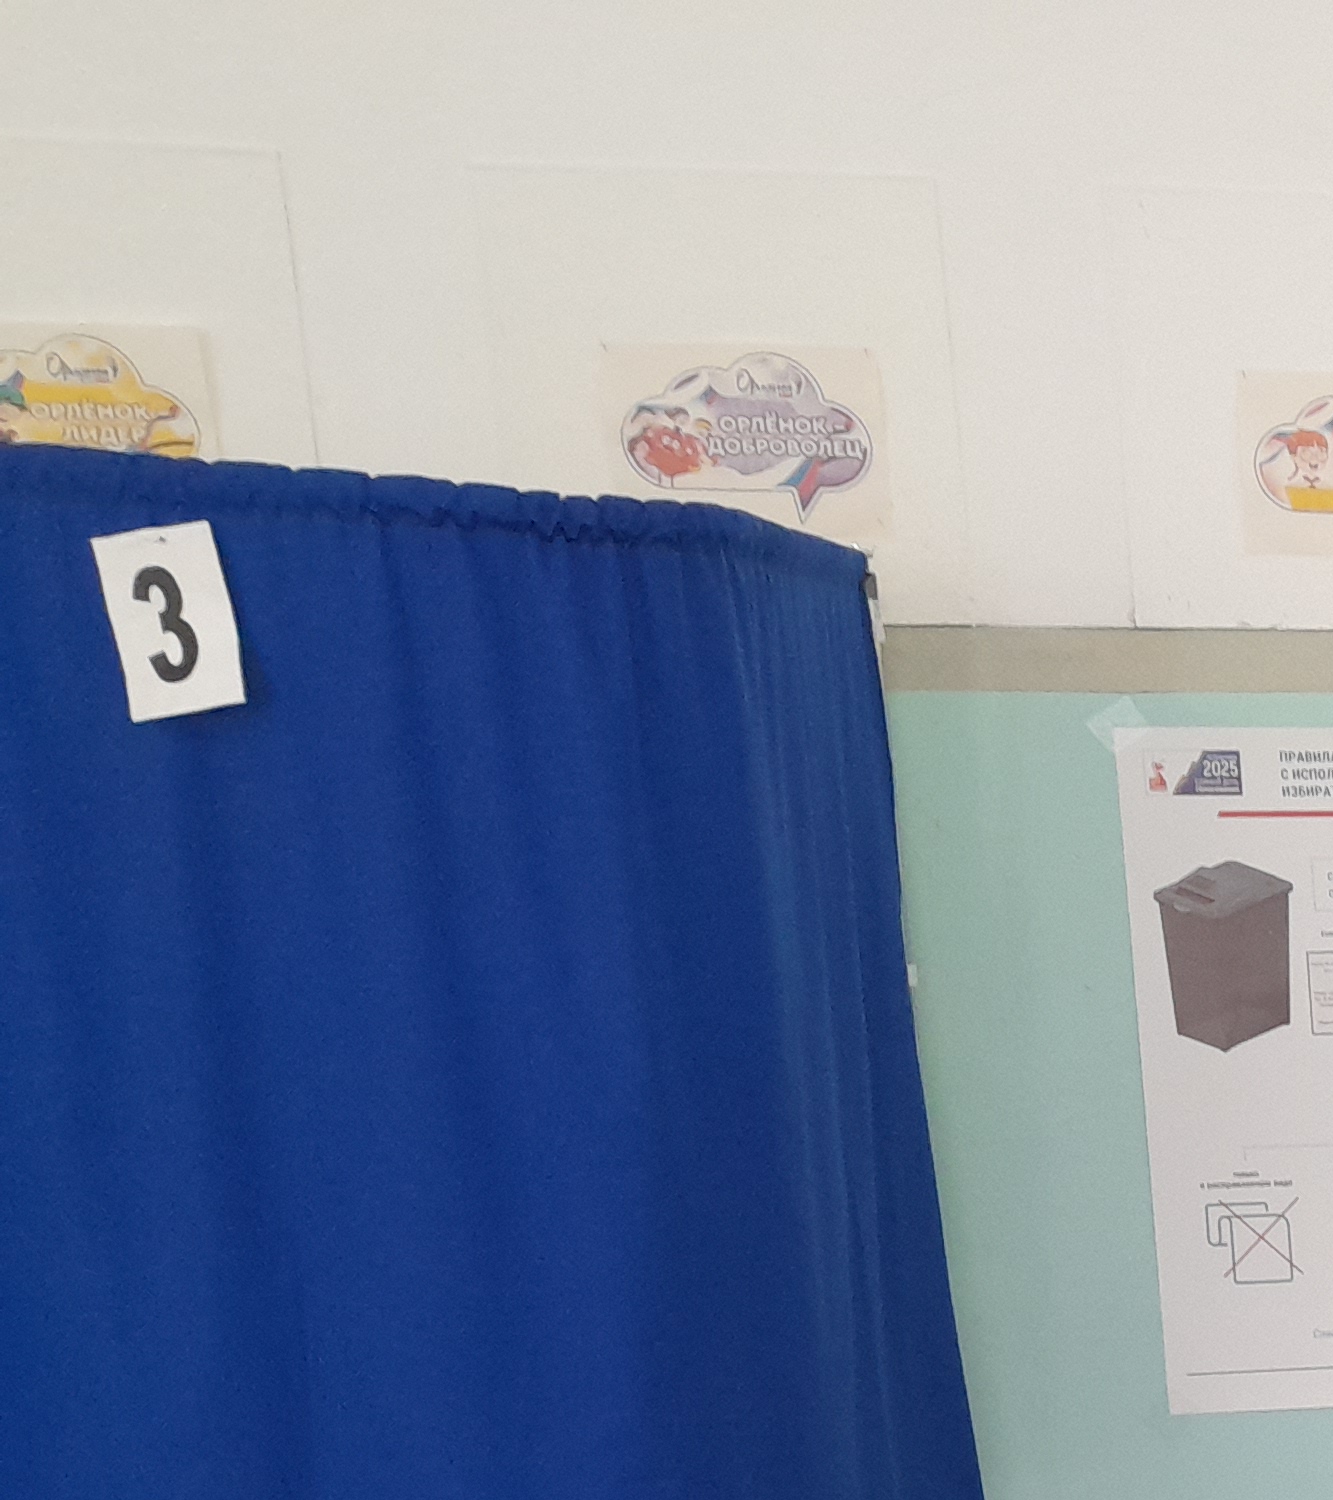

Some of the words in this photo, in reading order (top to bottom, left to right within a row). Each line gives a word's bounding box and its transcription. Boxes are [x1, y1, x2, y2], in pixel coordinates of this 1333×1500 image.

[708, 436, 863, 461] ДОБРОВОЛЕЦ
[132, 566, 199, 683] 3
[1203, 758, 1239, 778] 2025
[1280, 768, 1289, 780] С
